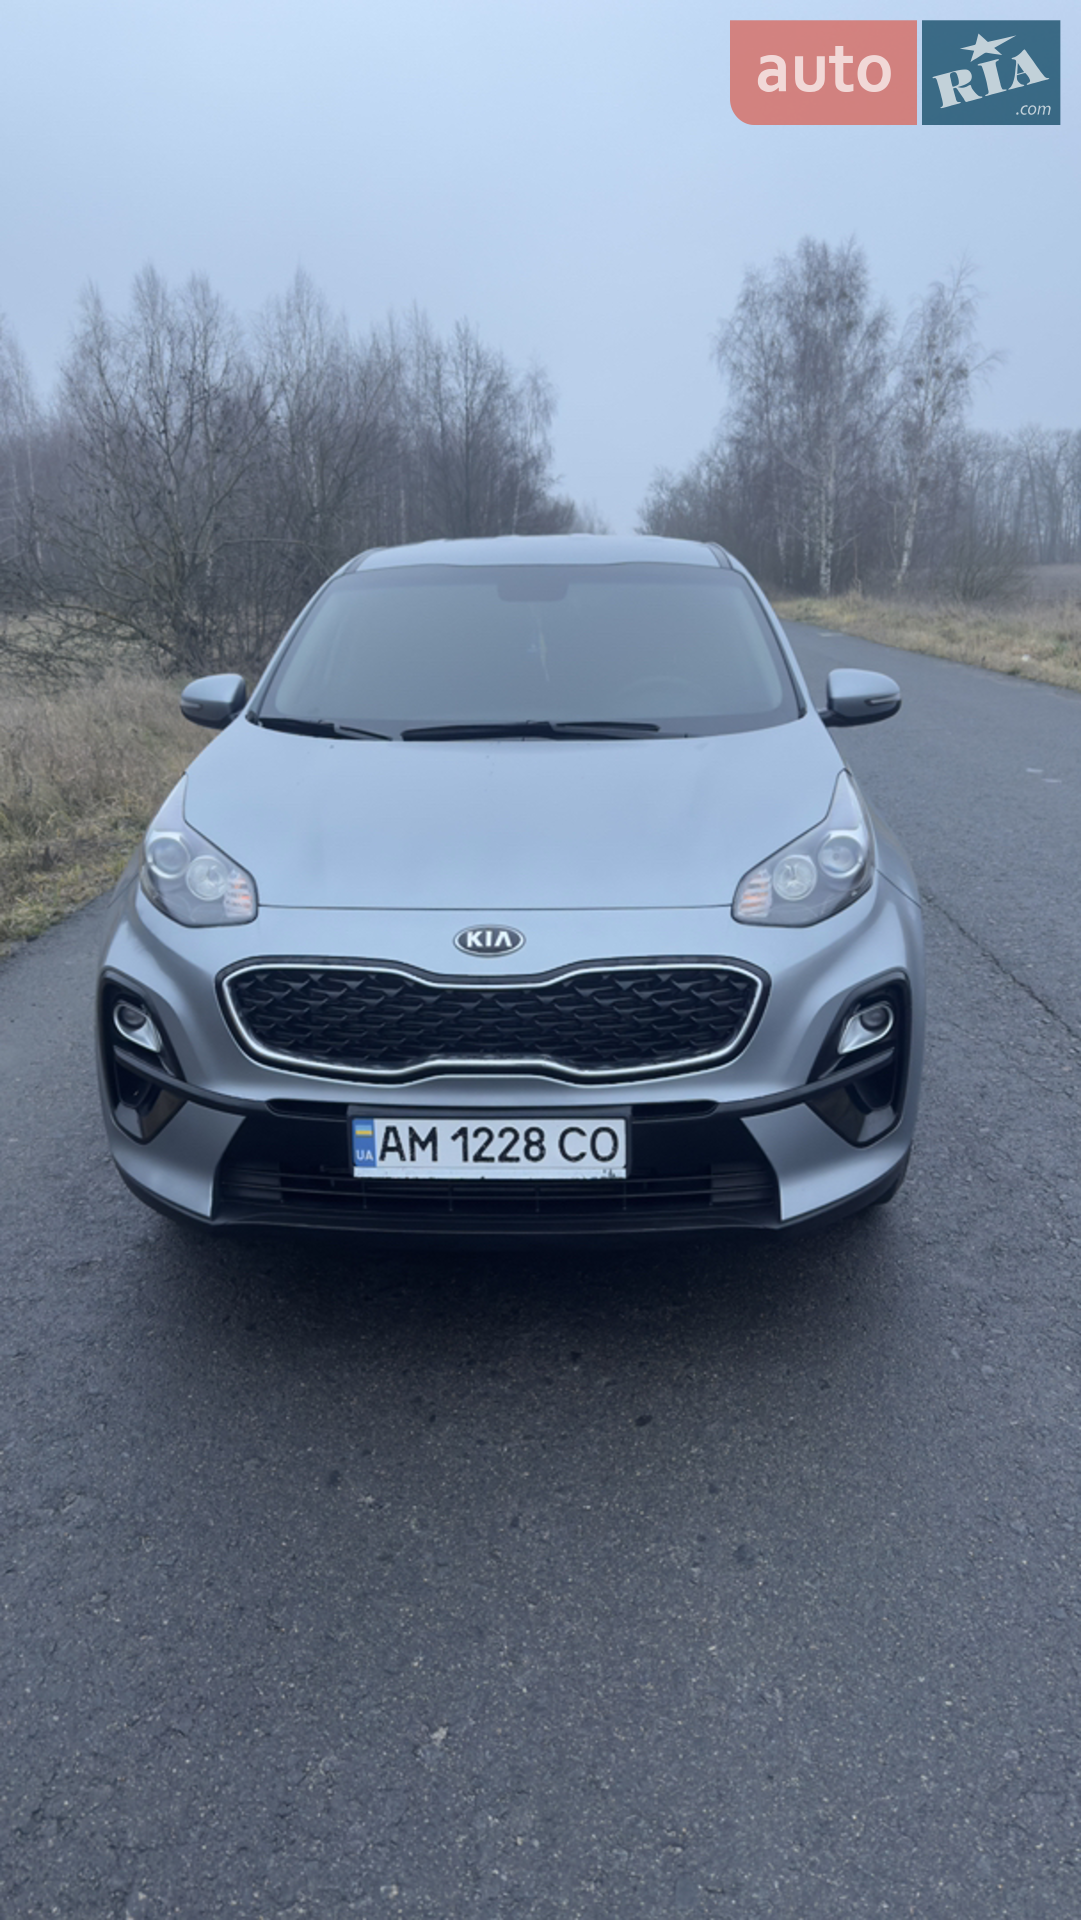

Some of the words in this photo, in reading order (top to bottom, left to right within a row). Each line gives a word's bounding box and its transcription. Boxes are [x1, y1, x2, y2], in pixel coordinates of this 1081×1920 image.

[466, 930, 513, 948] KIA
[378, 1125, 438, 1162] AM
[450, 1125, 547, 1163] 1228
[557, 1125, 620, 1163] CO
[356, 1149, 374, 1161] UA
